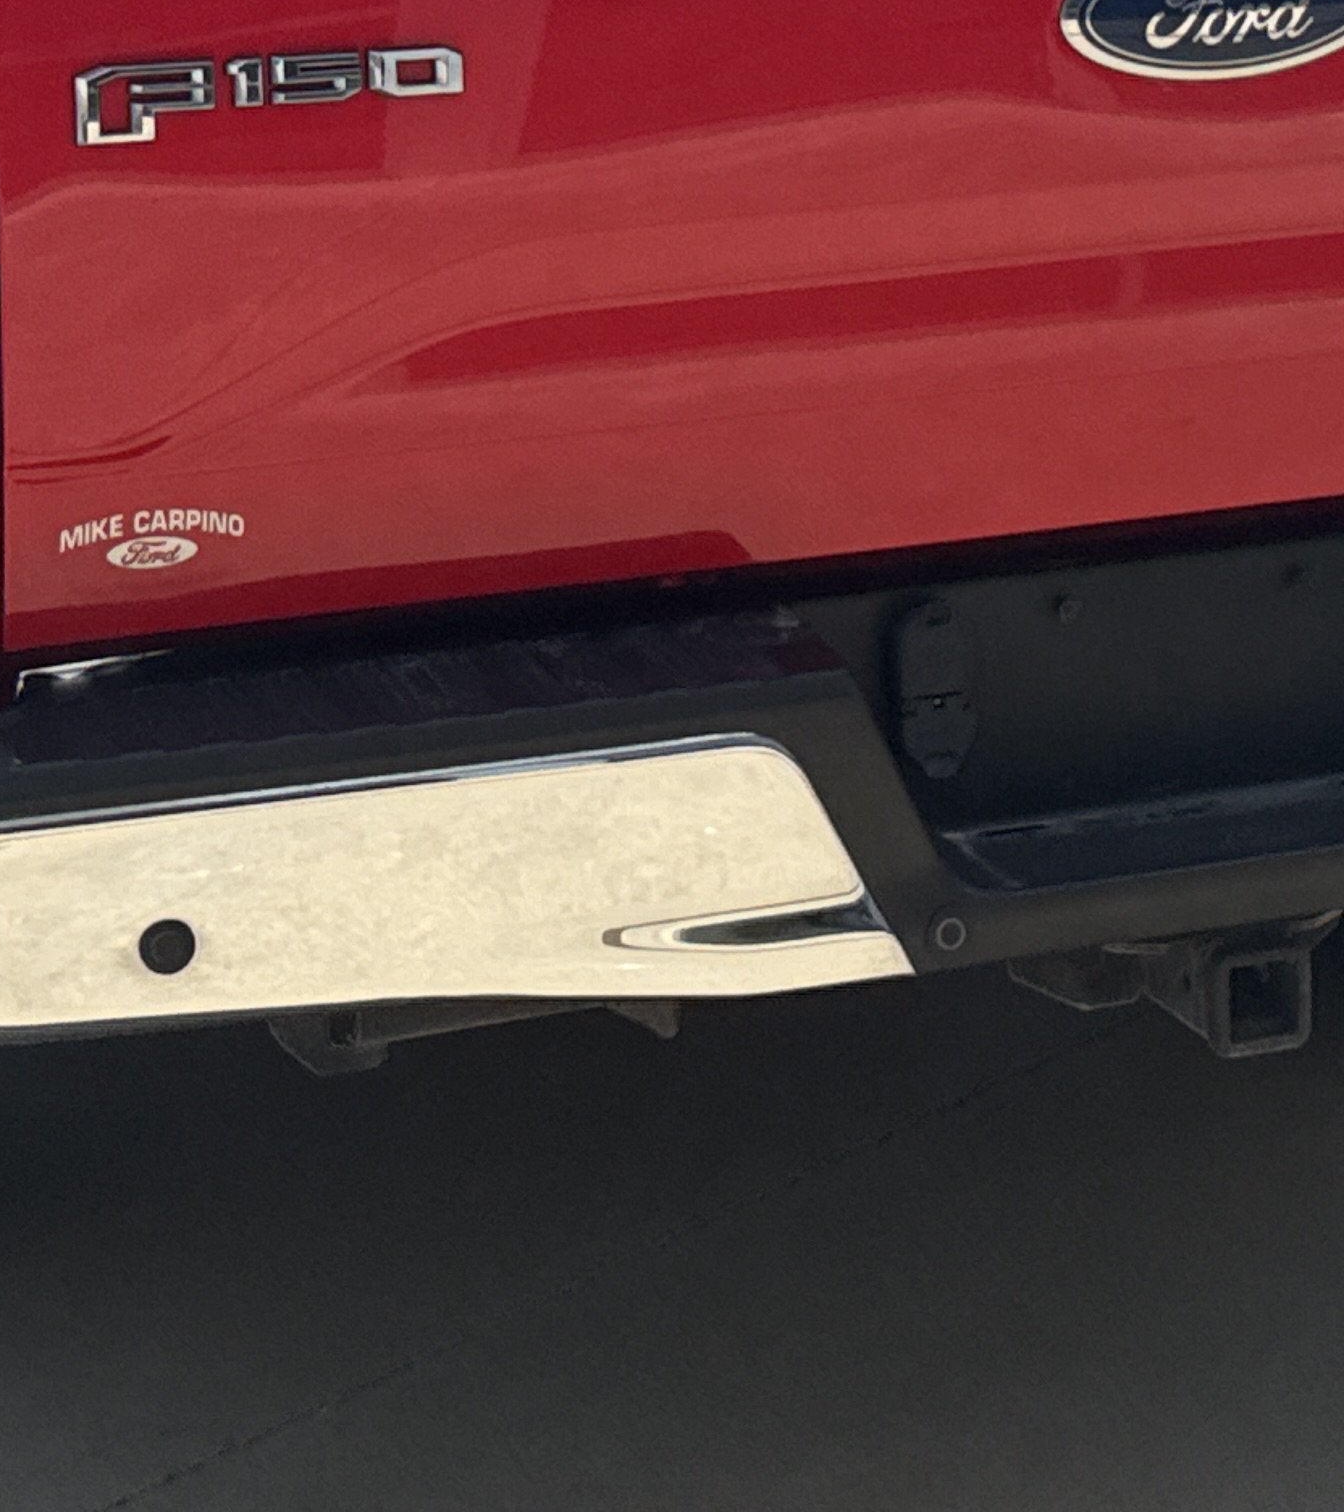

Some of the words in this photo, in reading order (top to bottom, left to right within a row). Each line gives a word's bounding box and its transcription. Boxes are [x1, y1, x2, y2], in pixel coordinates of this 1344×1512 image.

[59, 513, 125, 554] MIKE
[133, 508, 245, 538] CARPINO
[121, 540, 182, 566] Ford
